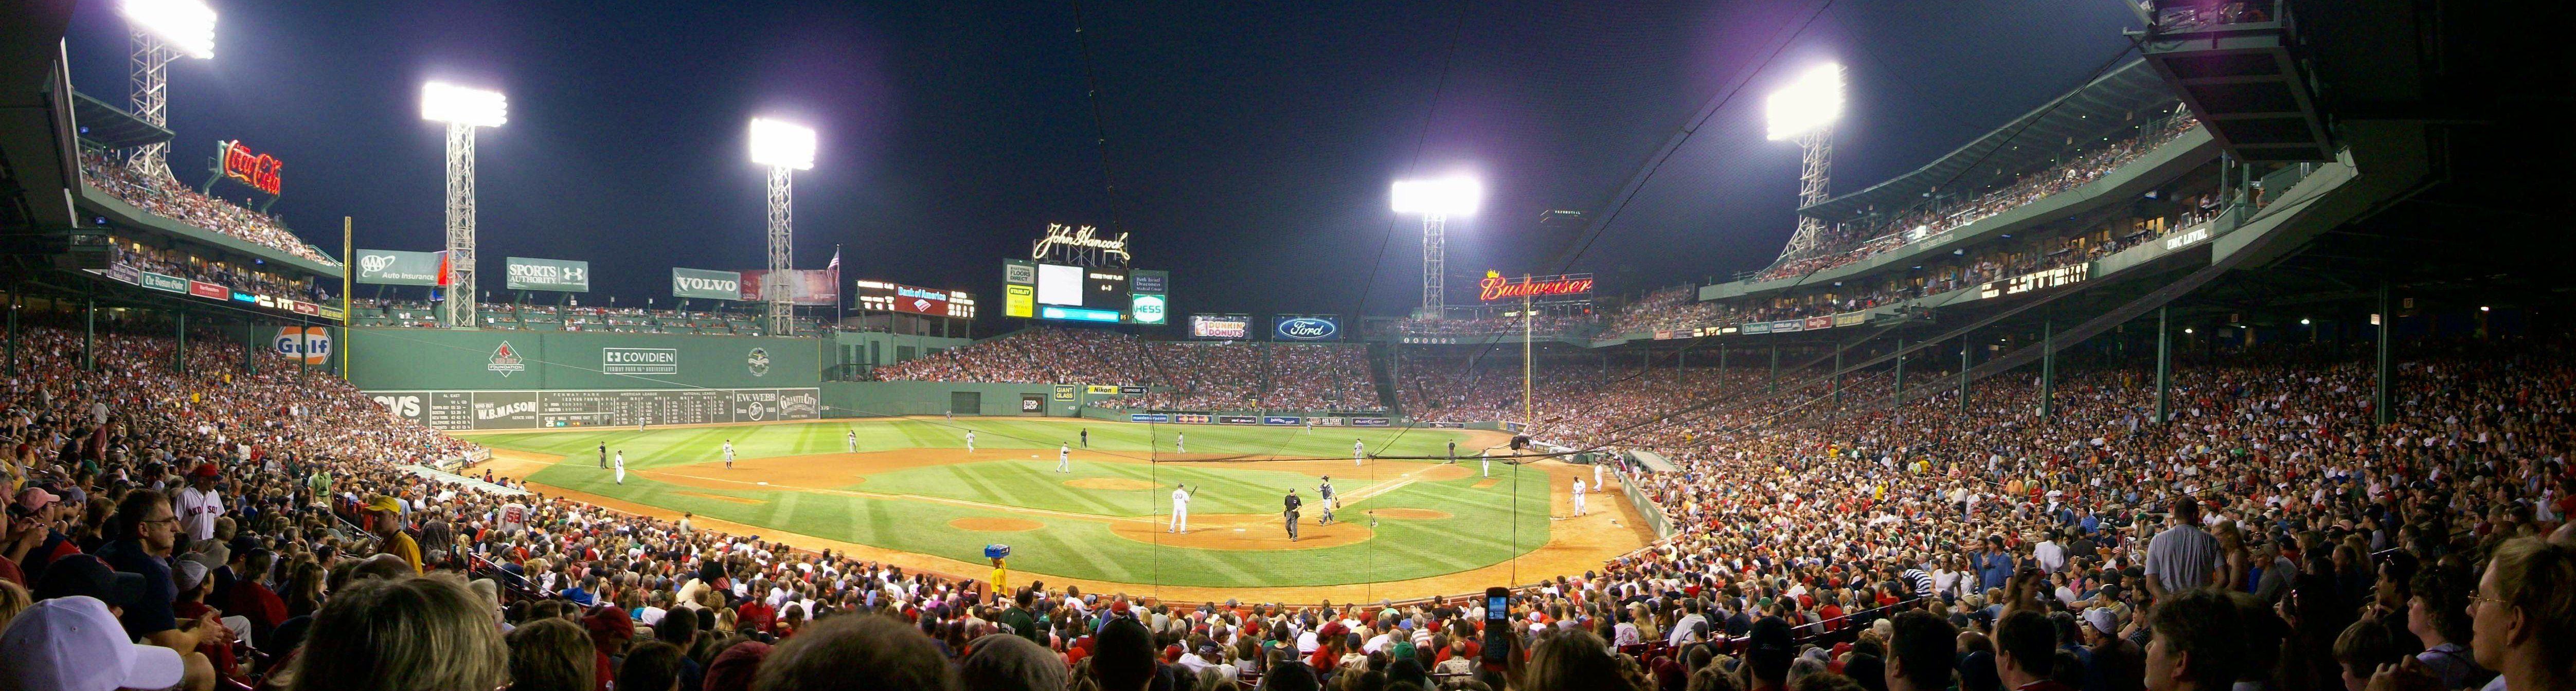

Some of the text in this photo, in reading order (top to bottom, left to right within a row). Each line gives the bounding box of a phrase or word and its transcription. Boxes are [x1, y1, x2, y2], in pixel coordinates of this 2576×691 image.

[1033, 223, 1130, 260] John Hancock
[2184, 228, 2207, 245] LEVEL
[364, 257, 382, 269] AAA
[509, 264, 557, 277] SPORTS
[677, 277, 737, 292] VOLVO
[1481, 276, 1592, 300] Budweiser
[1209, 322, 1245, 330] DUNKIN'
[1290, 321, 1323, 335] Ford
[278, 338, 327, 353] Gulf
[623, 353, 673, 362] COVIDIEN
[753, 393, 776, 402] WEBB
[780, 395, 803, 409] GRANITE
[803, 393, 817, 408] CITY
[188, 506, 202, 516] RED
[507, 512, 521, 523] 58
